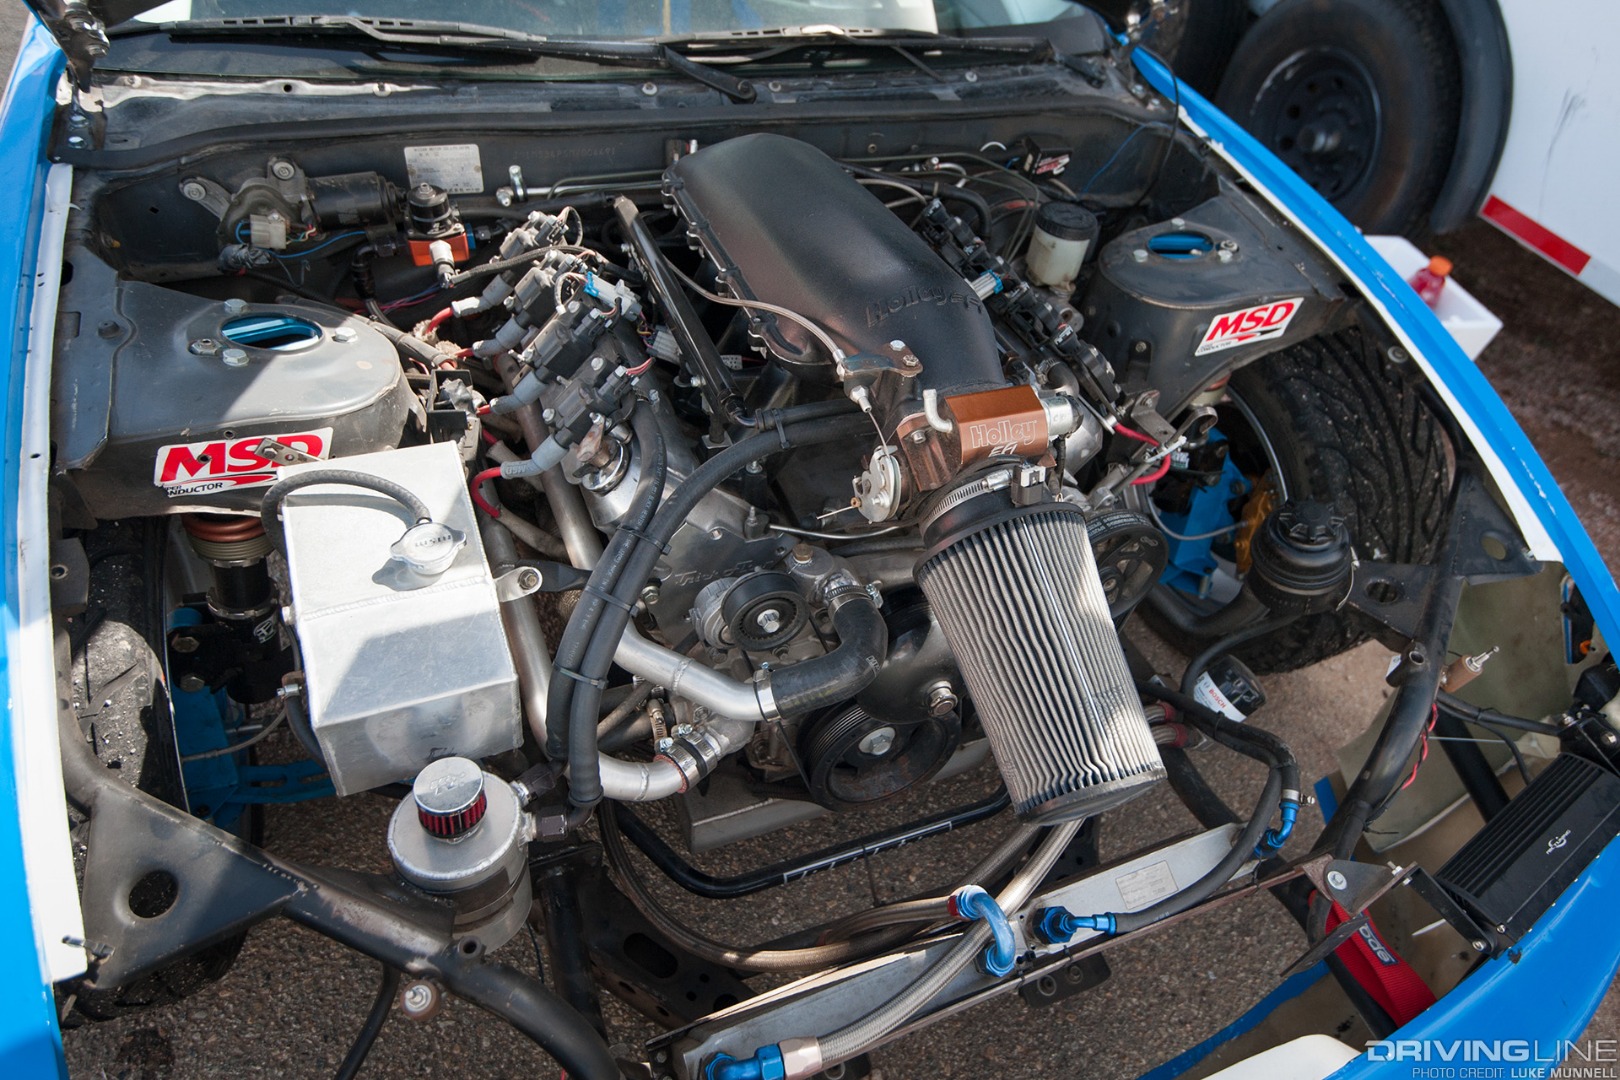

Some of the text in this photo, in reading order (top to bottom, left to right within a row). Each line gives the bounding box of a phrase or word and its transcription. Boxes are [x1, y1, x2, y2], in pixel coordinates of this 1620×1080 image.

[1206, 302, 1295, 342] MSD
[969, 420, 1036, 448] Holley
[160, 434, 323, 482] MSD
[169, 482, 224, 495] NDUCTOR
